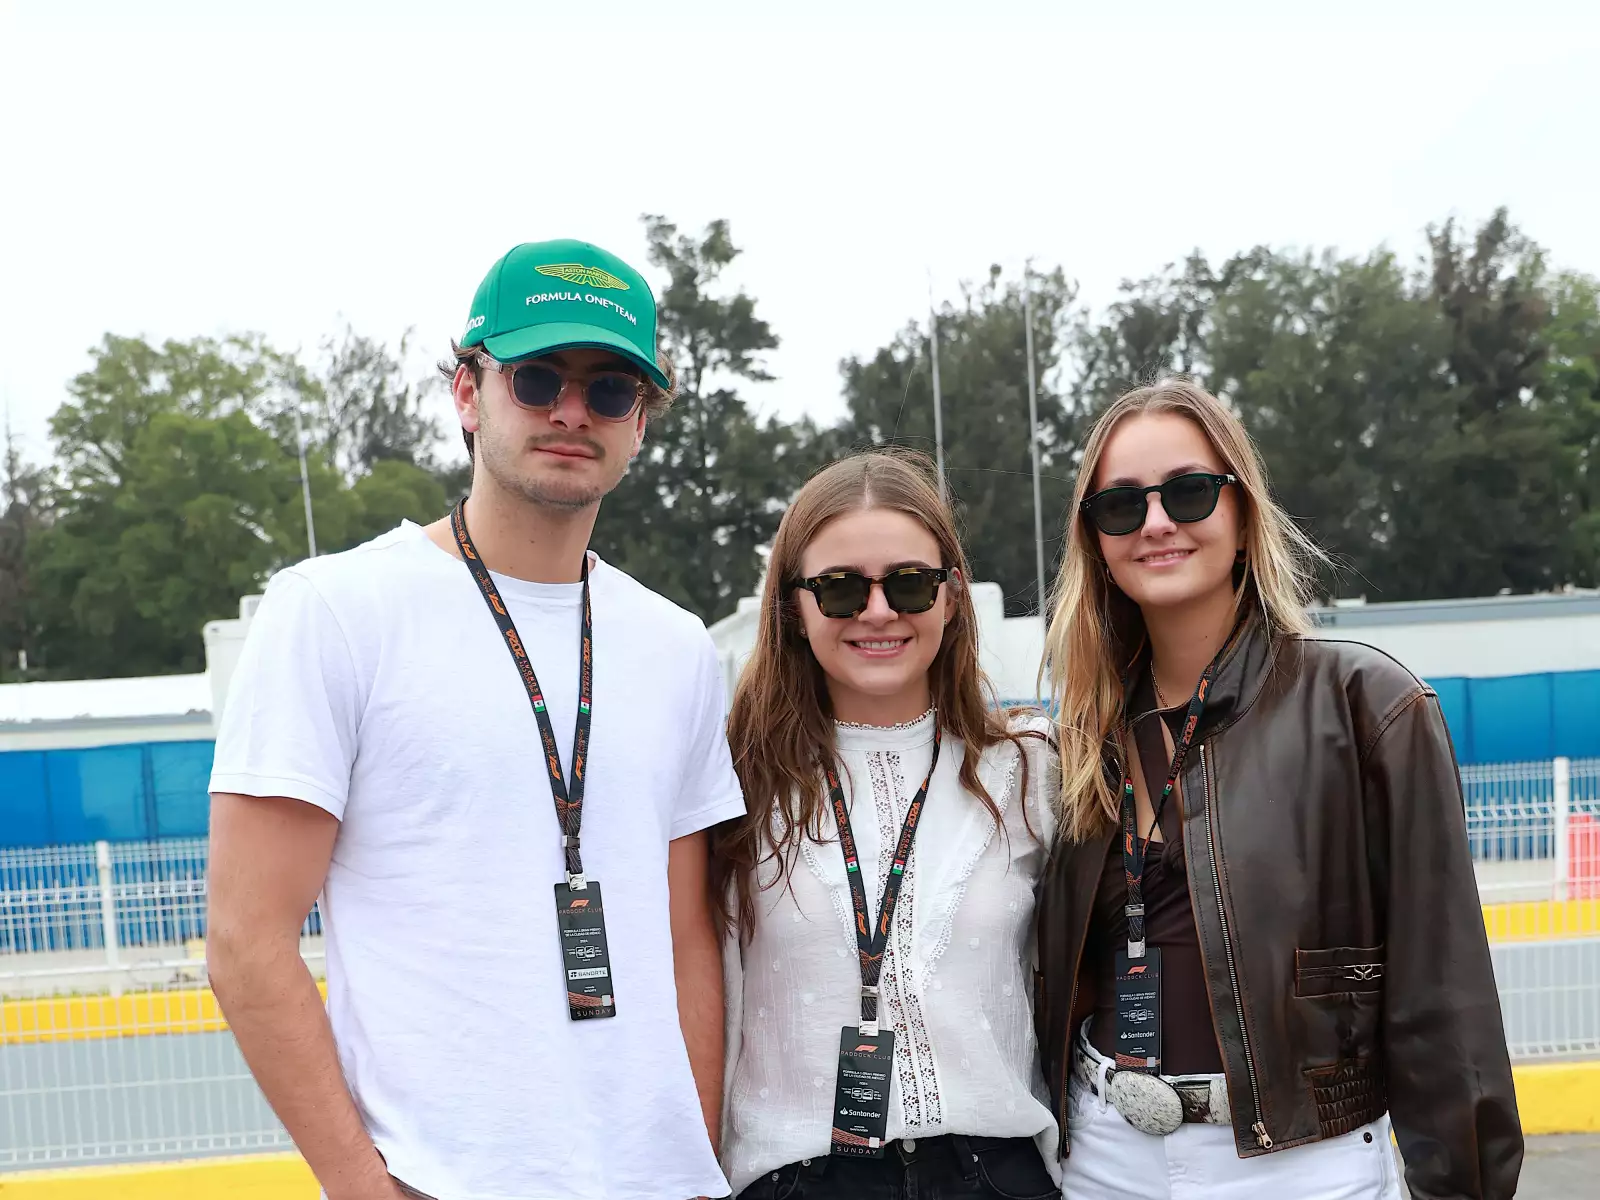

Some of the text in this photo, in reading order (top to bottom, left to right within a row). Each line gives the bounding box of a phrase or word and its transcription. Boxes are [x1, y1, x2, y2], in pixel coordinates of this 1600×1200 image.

[586, 268, 609, 281] MARTIN
[525, 292, 582, 306] FORMULA
[614, 304, 637, 326] TEAM
[907, 801, 920, 828] 2024
[578, 969, 607, 978] BANORTE
[576, 1009, 611, 1017] SUNDAY
[1127, 1031, 1156, 1039] Santander
[841, 1050, 872, 1058] PADDOCK
[848, 1109, 882, 1118] Santander
[836, 1145, 877, 1155] SUNDAY
